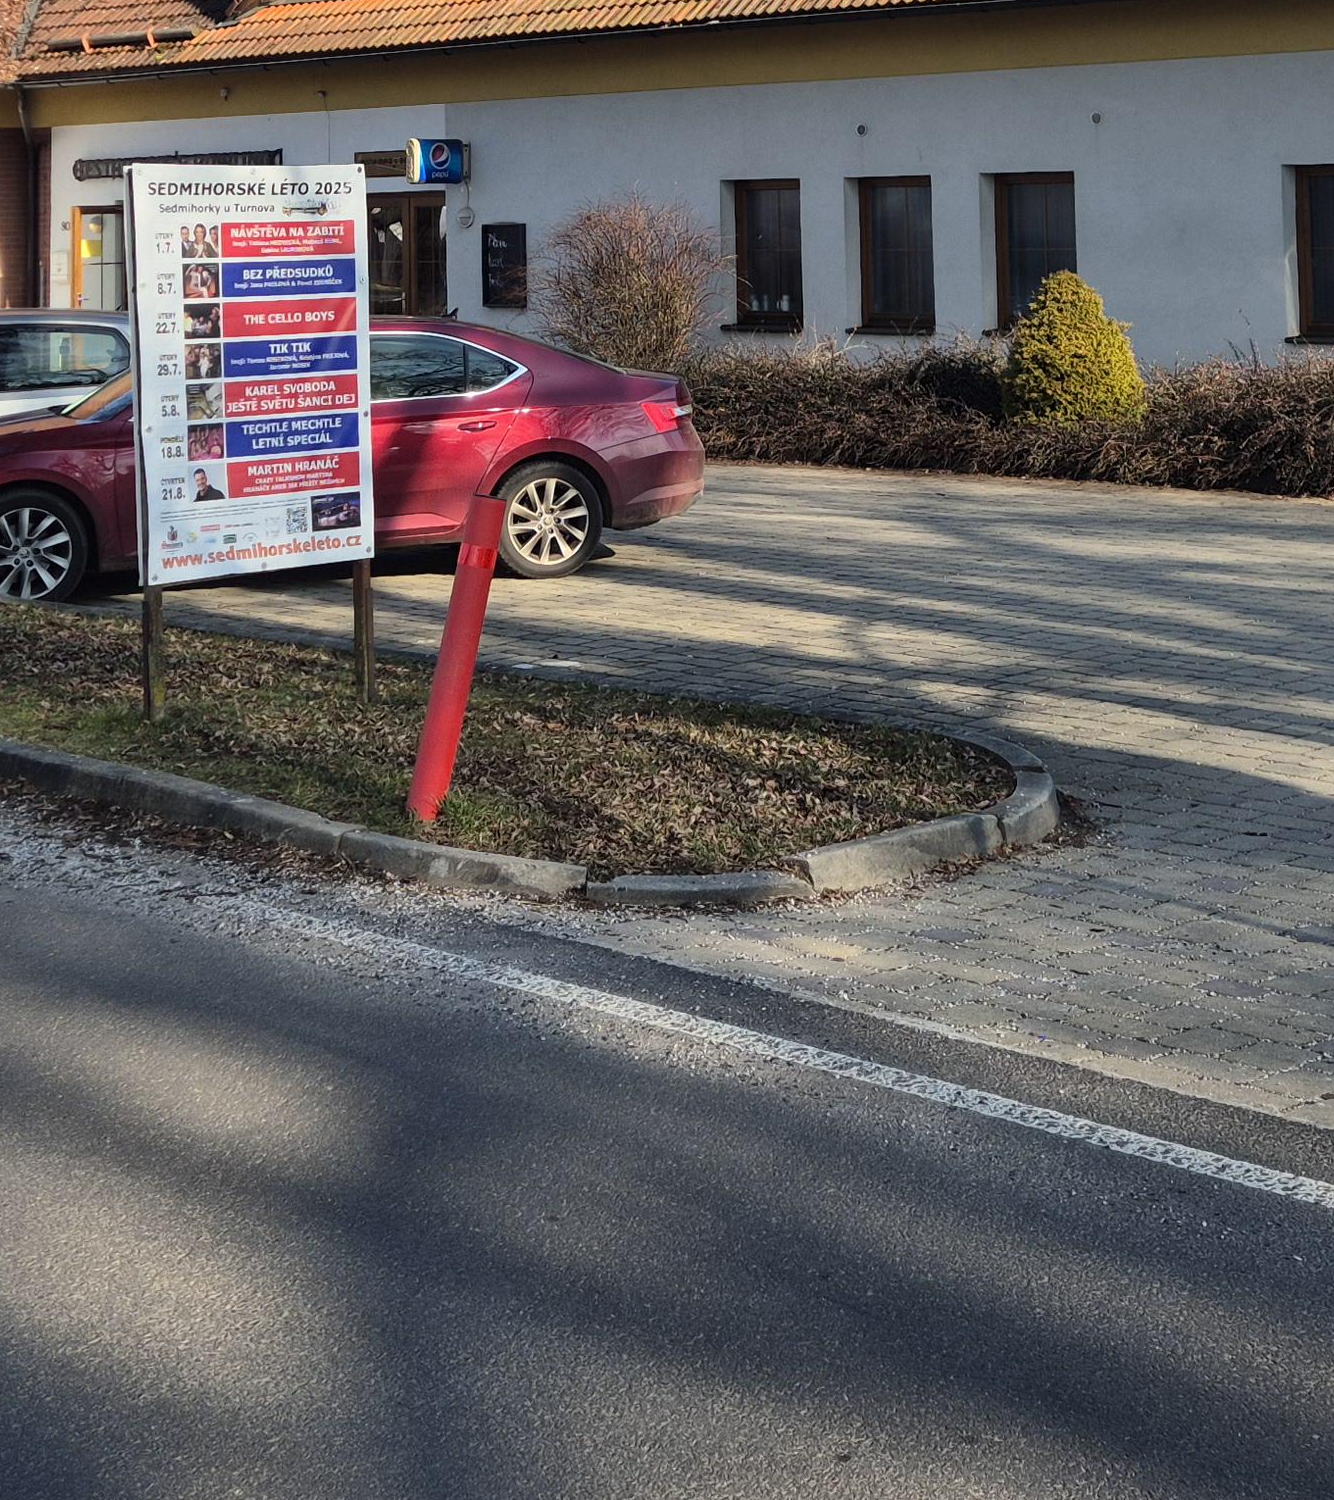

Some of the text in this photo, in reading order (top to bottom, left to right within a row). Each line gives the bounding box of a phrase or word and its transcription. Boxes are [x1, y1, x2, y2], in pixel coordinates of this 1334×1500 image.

[148, 179, 352, 196] SEDMIHORSKÉ LÉTO 2025
[159, 204, 220, 214] Sedmihorky
[234, 203, 275, 213] Turnova
[230, 223, 344, 238] NÁVŠTĚVA NA ZABITÍ
[156, 242, 175, 254] 1.7.
[243, 264, 333, 280] BEZ PŘEDSUDKŮ
[157, 283, 176, 294] 8.7.
[243, 311, 335, 325] THE CELLO BOYS
[155, 322, 180, 334] 22.7.
[269, 341, 311, 354] TIK TIK
[157, 364, 182, 376] 29.7.
[245, 381, 336, 397] KAREL SVOBODA
[226, 394, 355, 413] JEŠTĚ SVĚTU ŠANCI DEJ
[161, 405, 180, 417] 5.8.
[241, 417, 342, 435] TECHTLE MECHTLE
[252, 430, 333, 449] LETNÍ SPECIÁL
[161, 446, 185, 458] 18.8.
[248, 455, 340, 476] MARTIN HRANÁČ
[161, 488, 186, 500] 21.8.
[162, 533, 362, 569] www.sedmihorskeleto.cz
